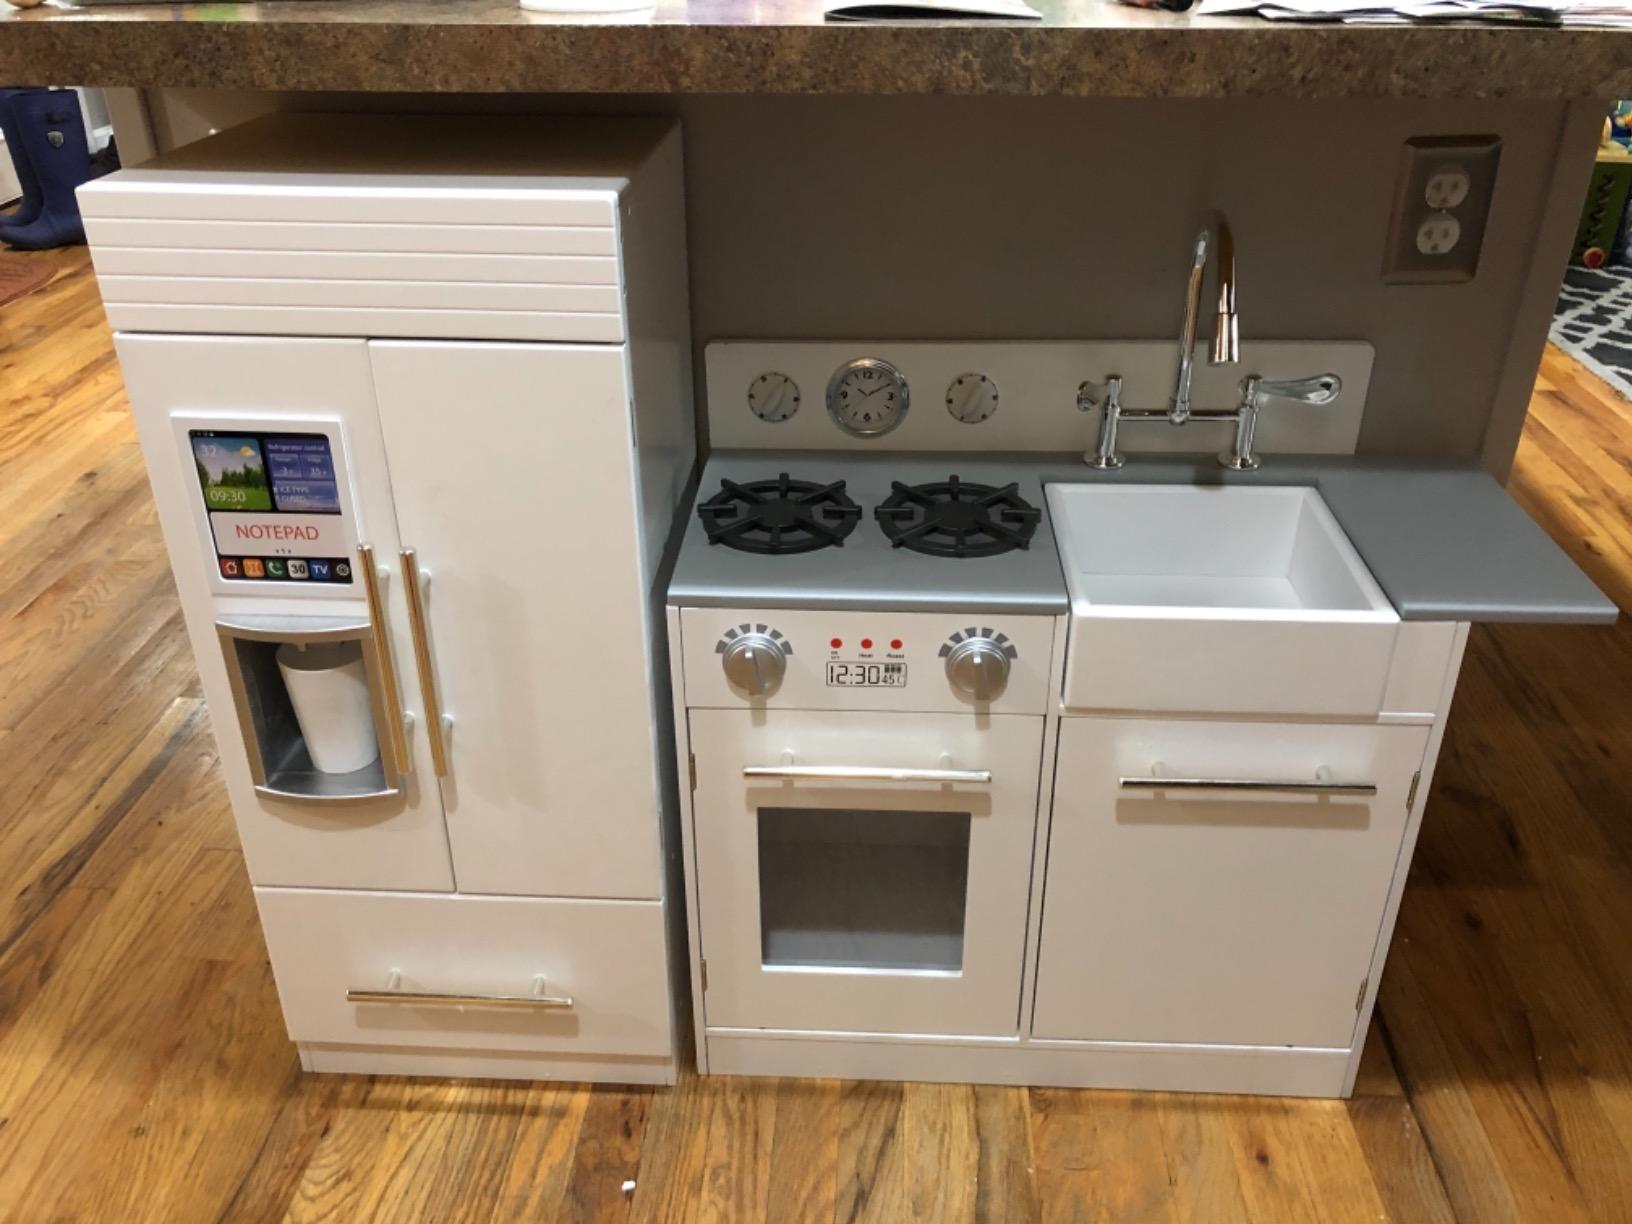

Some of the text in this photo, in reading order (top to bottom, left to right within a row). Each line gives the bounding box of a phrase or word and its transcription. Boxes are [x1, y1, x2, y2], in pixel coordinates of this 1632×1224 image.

[863, 371, 873, 379] 12
[841, 390, 848, 399] 9
[887, 392, 894, 400] 3
[863, 412, 871, 421] 6
[210, 489, 246, 503] 09:30
[235, 525, 320, 541] NOTEPAD
[291, 564, 306, 574] 30
[312, 565, 328, 575] TV
[830, 665, 880, 685] 12:30
